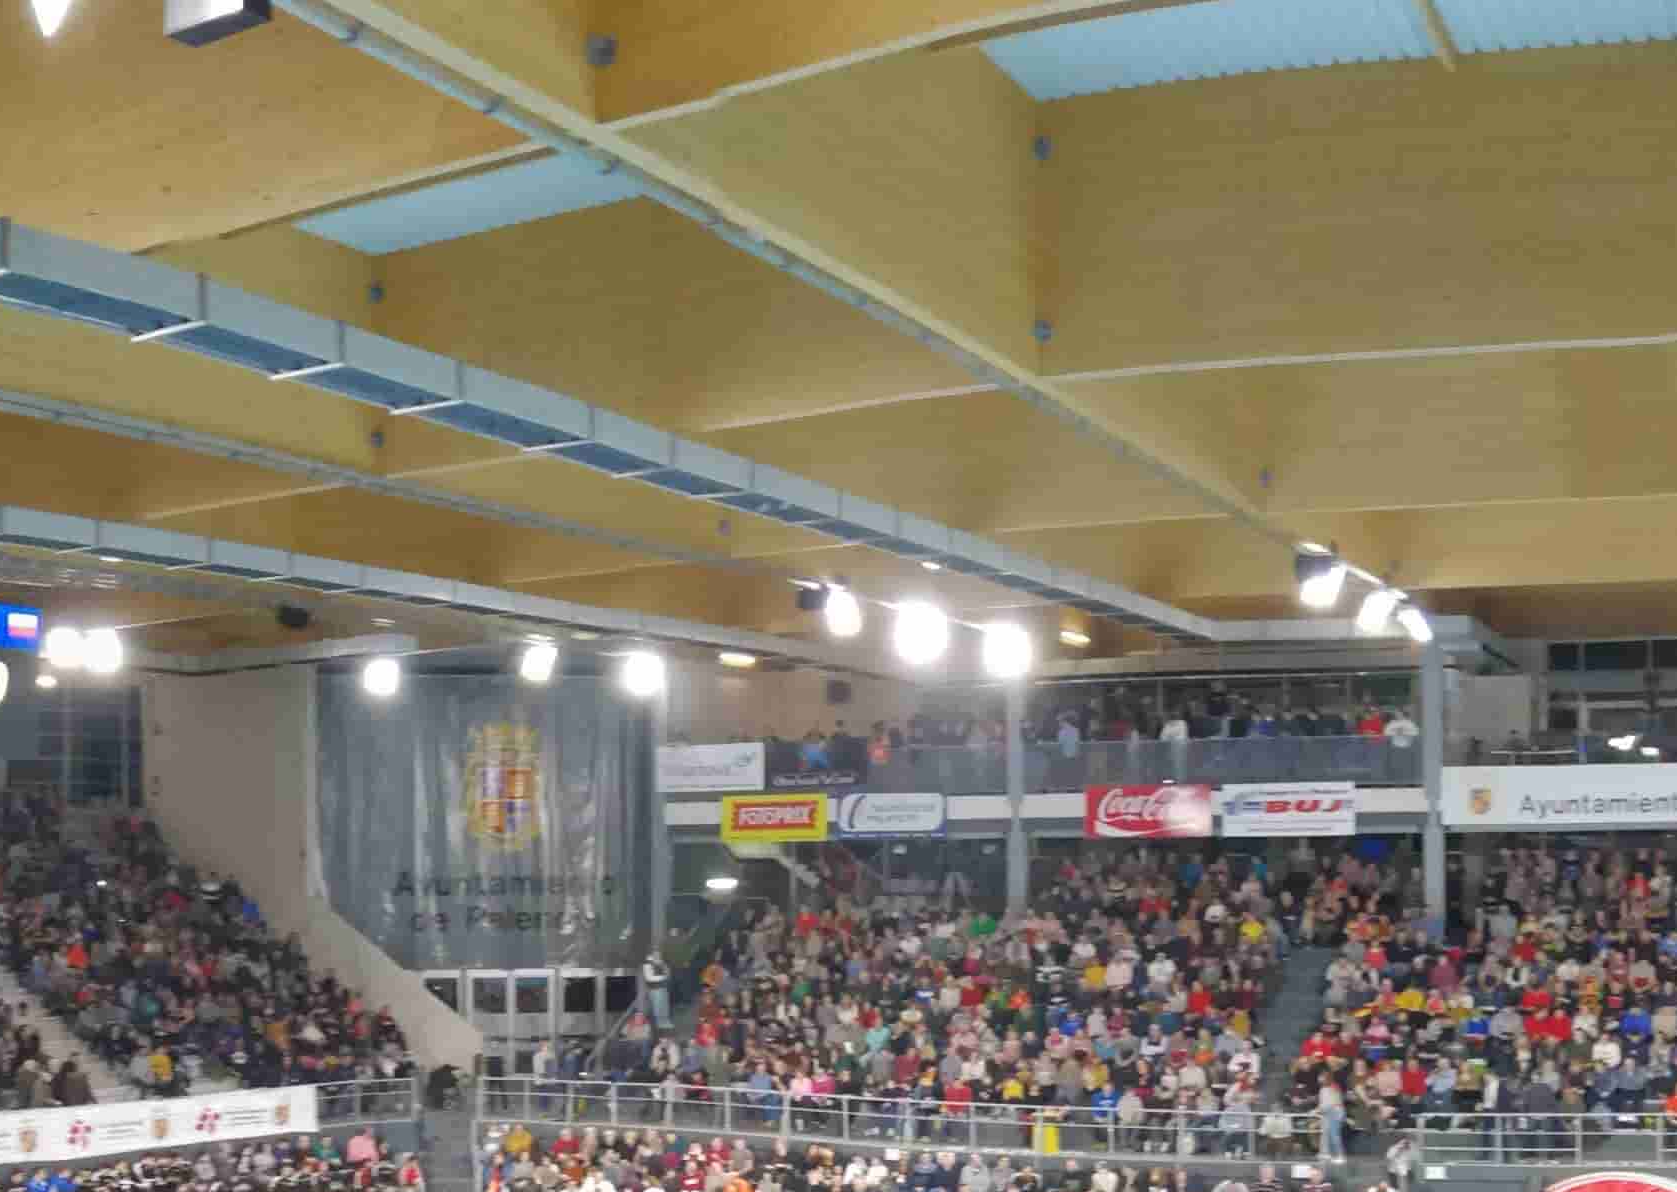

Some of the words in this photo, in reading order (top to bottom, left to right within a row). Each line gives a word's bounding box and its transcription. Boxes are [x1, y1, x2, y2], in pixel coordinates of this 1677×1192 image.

[393, 871, 616, 900] Ayuntamiento
[411, 904, 451, 932] de
[466, 904, 601, 932] Palencia
